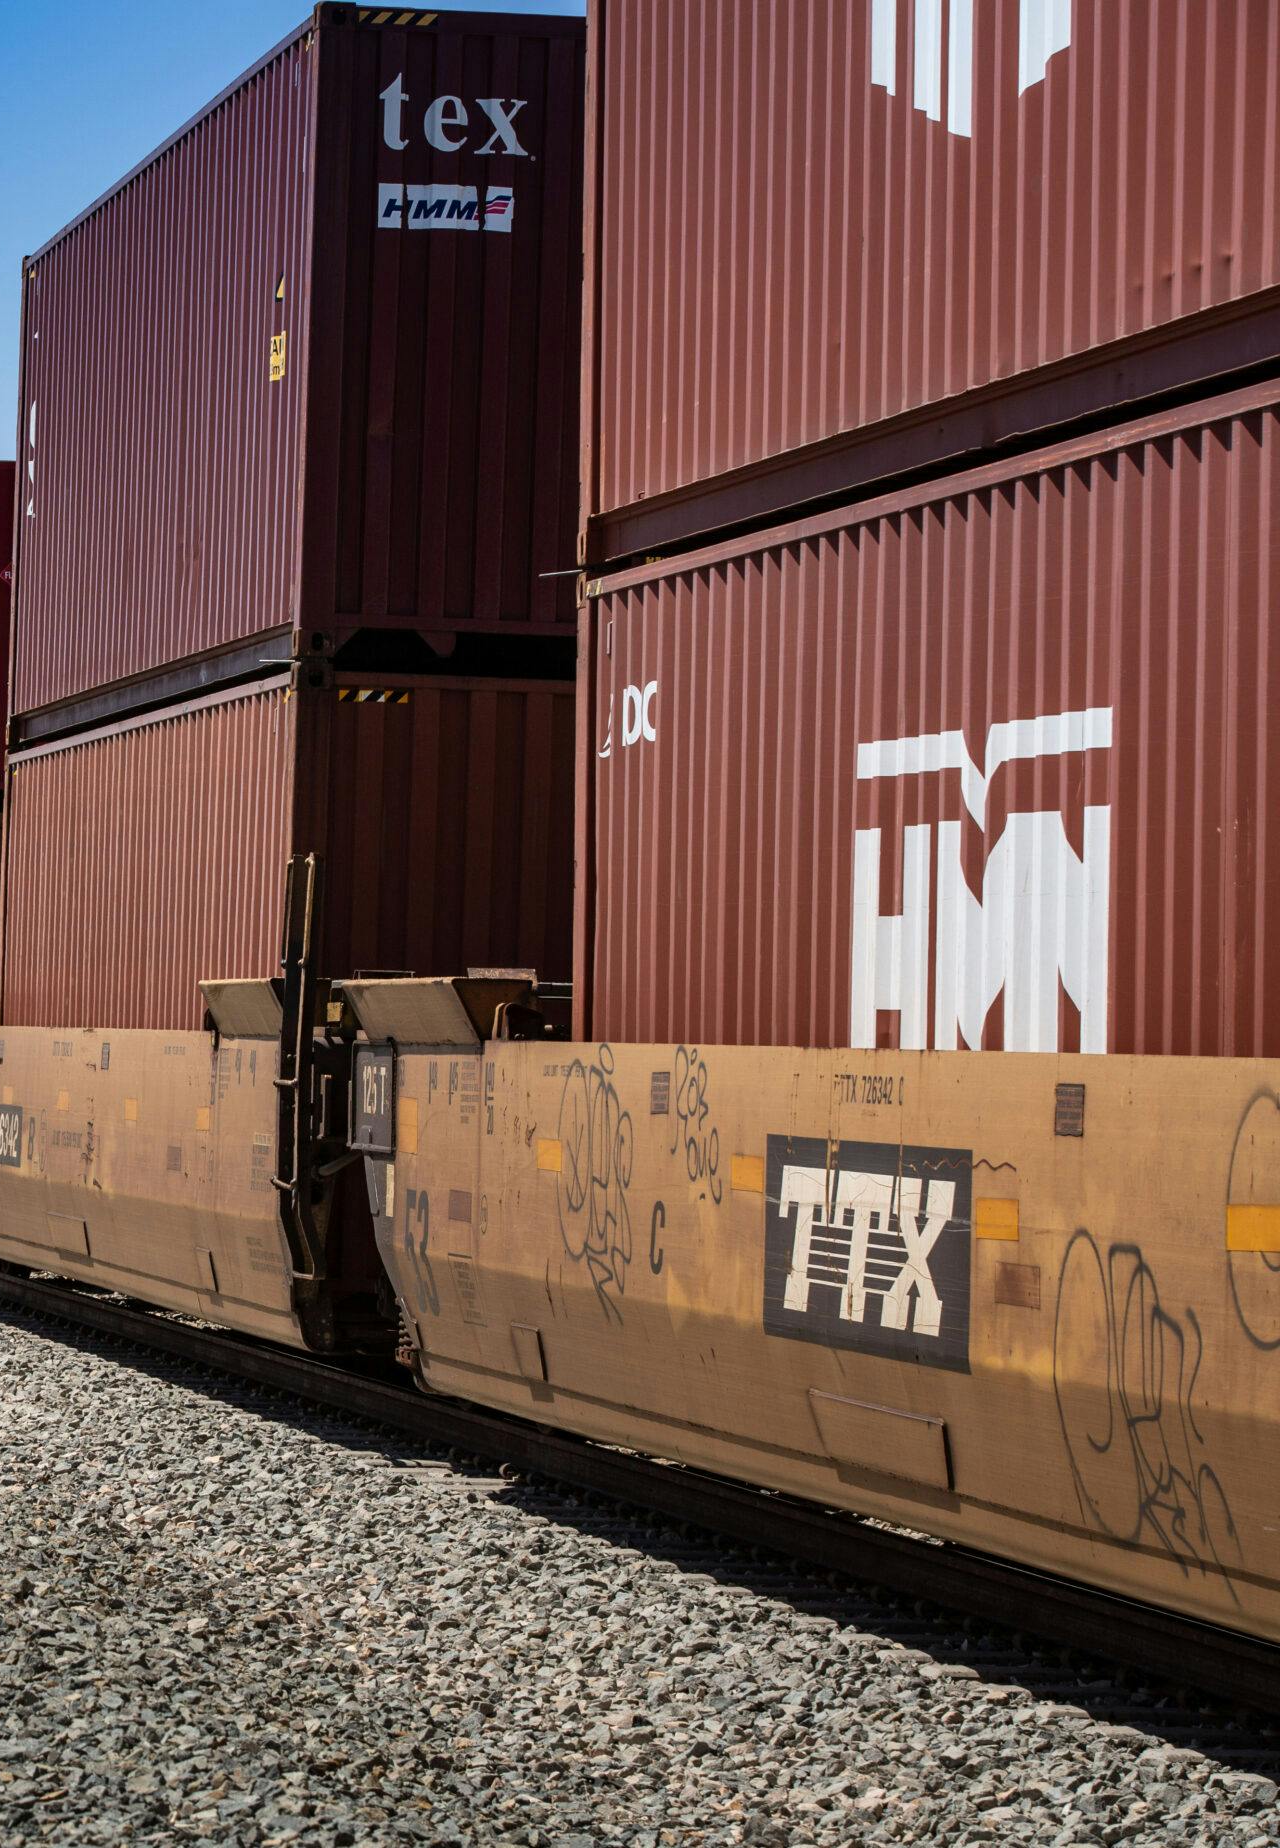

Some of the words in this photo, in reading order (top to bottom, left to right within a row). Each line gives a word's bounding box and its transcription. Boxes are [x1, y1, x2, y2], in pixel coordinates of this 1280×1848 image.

[379, 72, 529, 156] tex
[382, 198, 478, 221] HMM
[861, 1075, 893, 1105] 726342
[405, 1188, 441, 1317] 53
[650, 1200, 666, 1275] C
[779, 1164, 956, 1337] TTX
